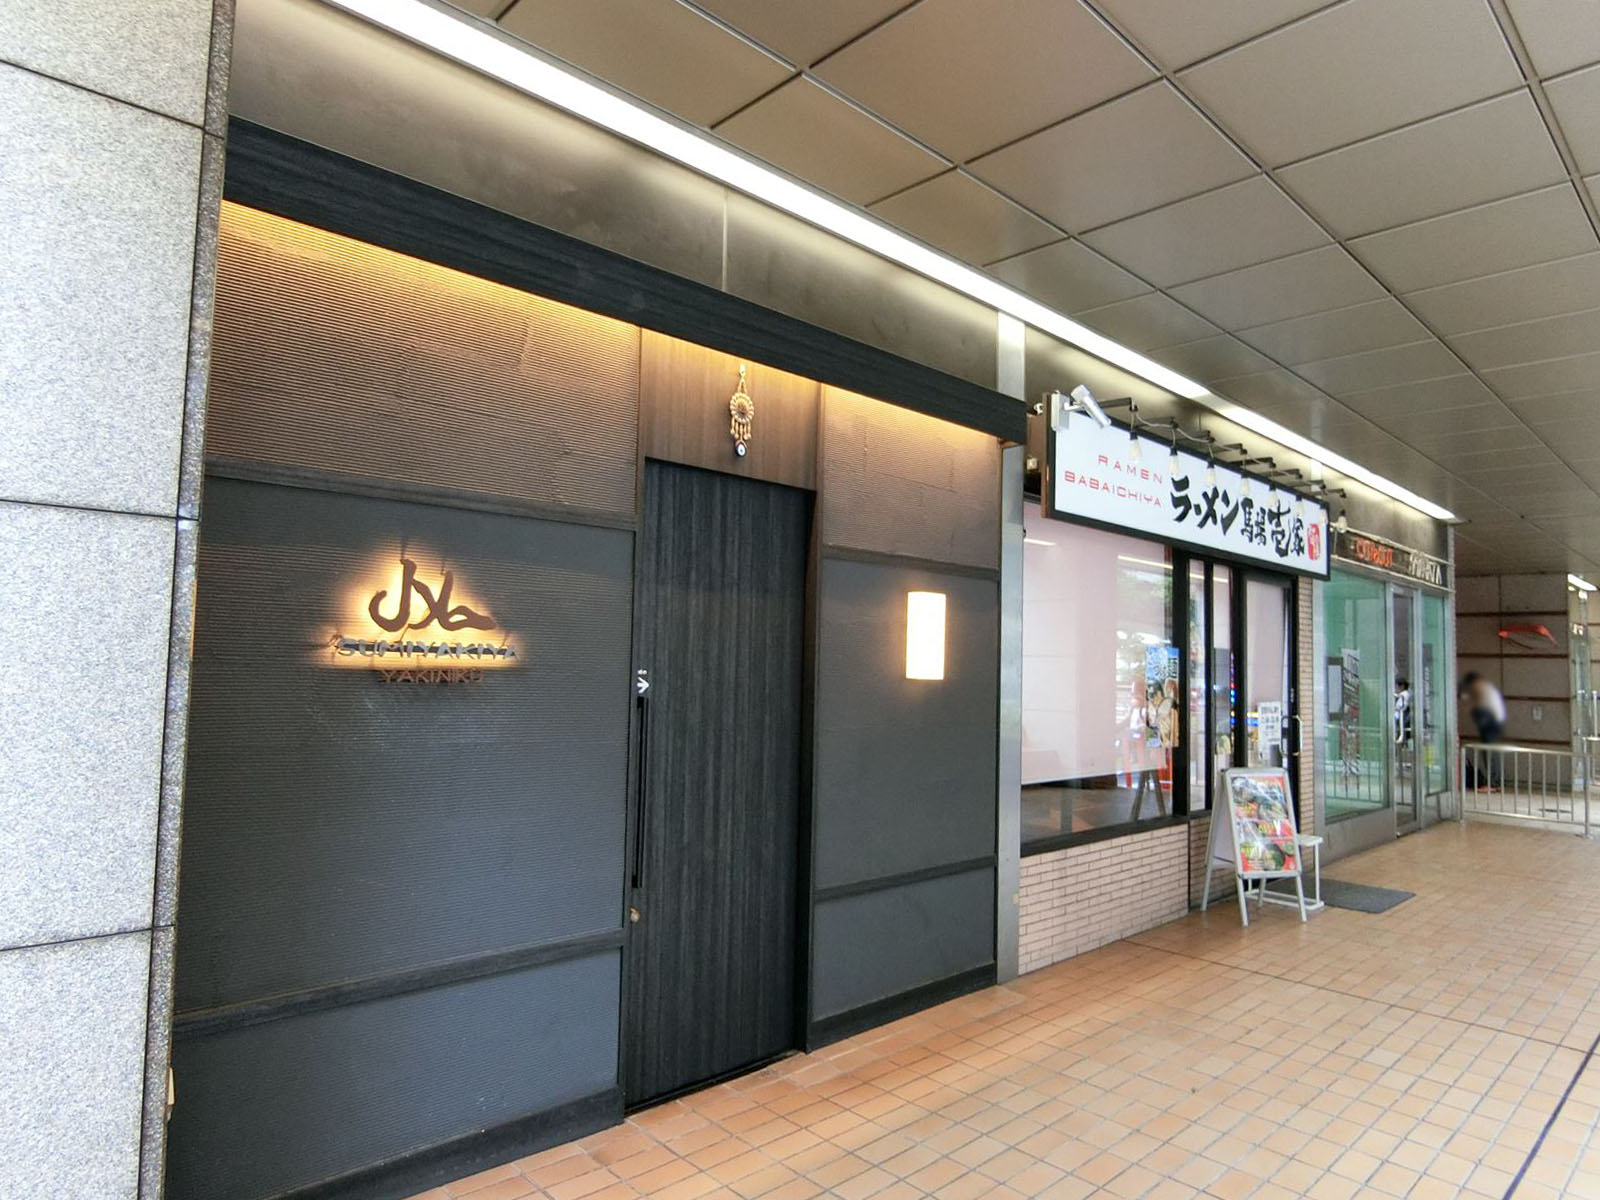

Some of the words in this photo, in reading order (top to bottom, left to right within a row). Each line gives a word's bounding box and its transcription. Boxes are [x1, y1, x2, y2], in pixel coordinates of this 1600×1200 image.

[1097, 454, 1163, 484] RAMEN
[1063, 470, 1162, 508] BABAICHIYA
[337, 638, 521, 660] SUMIYAKIYA
[381, 669, 484, 684] YAKINIKU
